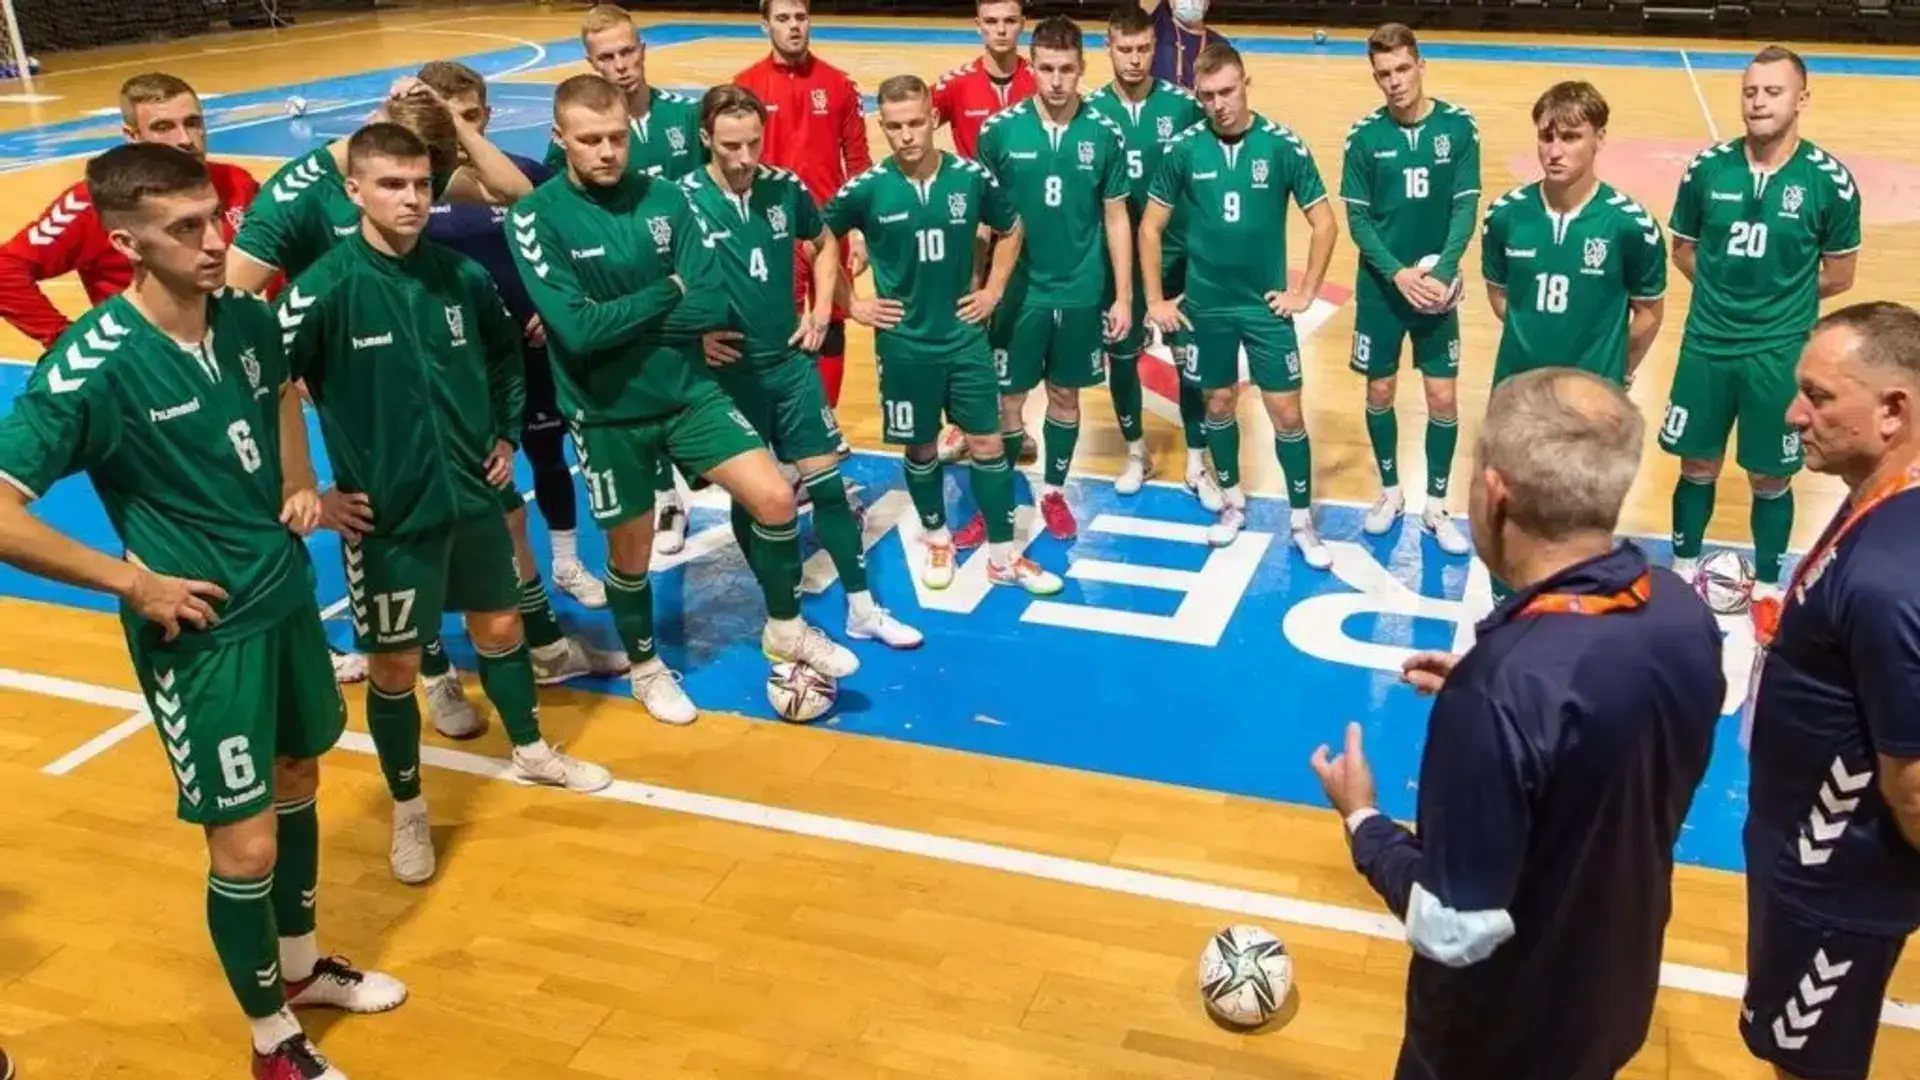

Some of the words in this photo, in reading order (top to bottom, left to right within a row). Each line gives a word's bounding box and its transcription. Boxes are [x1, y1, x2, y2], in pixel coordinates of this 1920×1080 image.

[1127, 150, 1143, 179] 5
[1044, 176, 1062, 206] 8
[1403, 167, 1430, 198] 16
[1224, 192, 1240, 222] 9
[915, 228, 944, 261] 10
[1727, 221, 1768, 258] 20
[749, 247, 768, 281] 4
[1535, 272, 1570, 313] 18
[149, 396, 200, 422] hummel
[885, 399, 914, 430] 10
[227, 419, 262, 474] 6
[588, 468, 618, 509] 11
[373, 588, 416, 633] 17
[218, 735, 256, 791] 6
[216, 780, 266, 809] hummel
